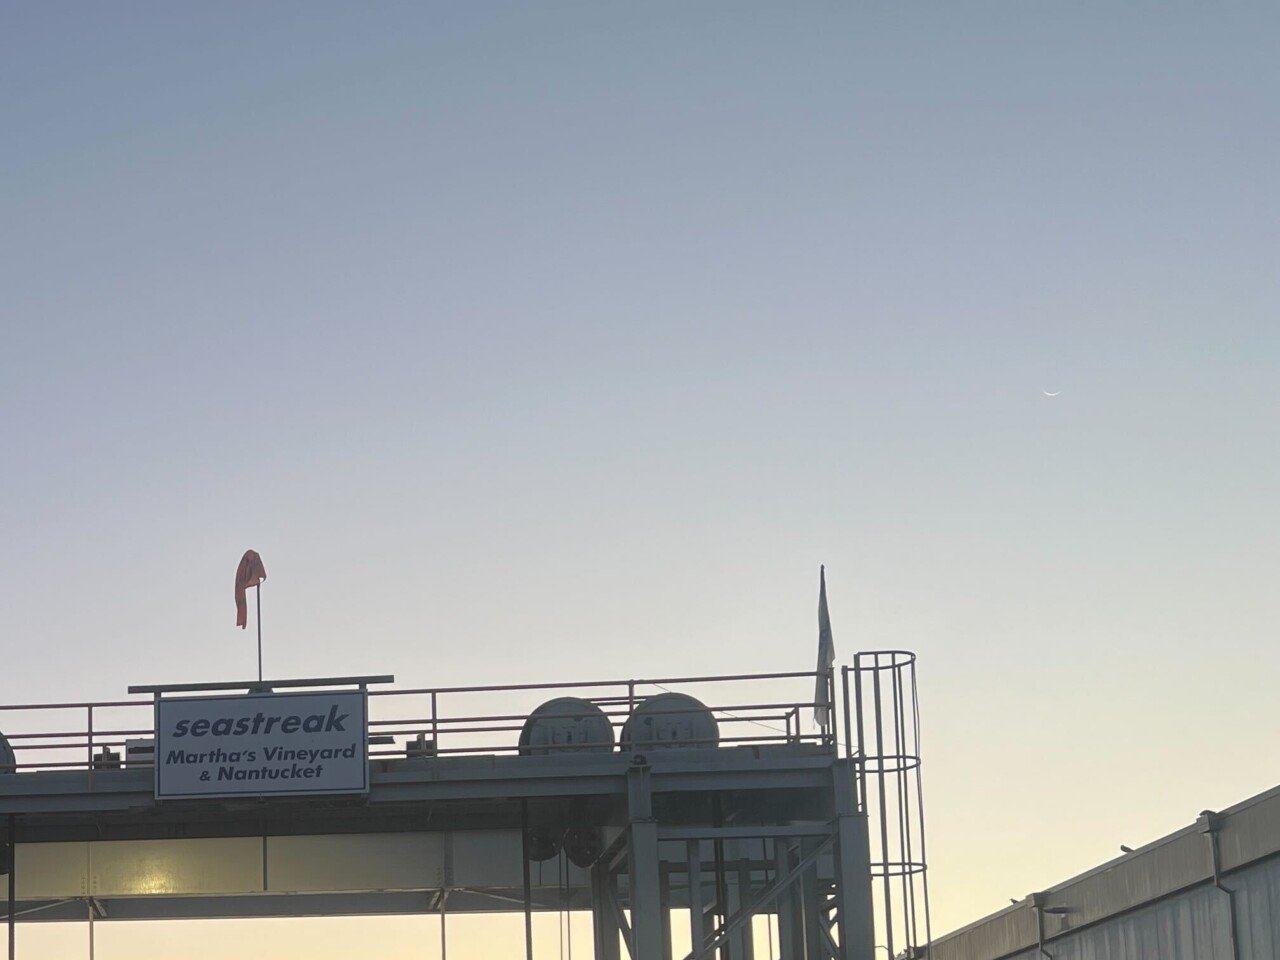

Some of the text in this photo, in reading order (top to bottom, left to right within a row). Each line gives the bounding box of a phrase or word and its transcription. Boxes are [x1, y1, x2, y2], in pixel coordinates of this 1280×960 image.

[172, 704, 350, 738] seastreak
[166, 743, 356, 765] Martha's Vineyard
[199, 763, 323, 781] & Nantucket
